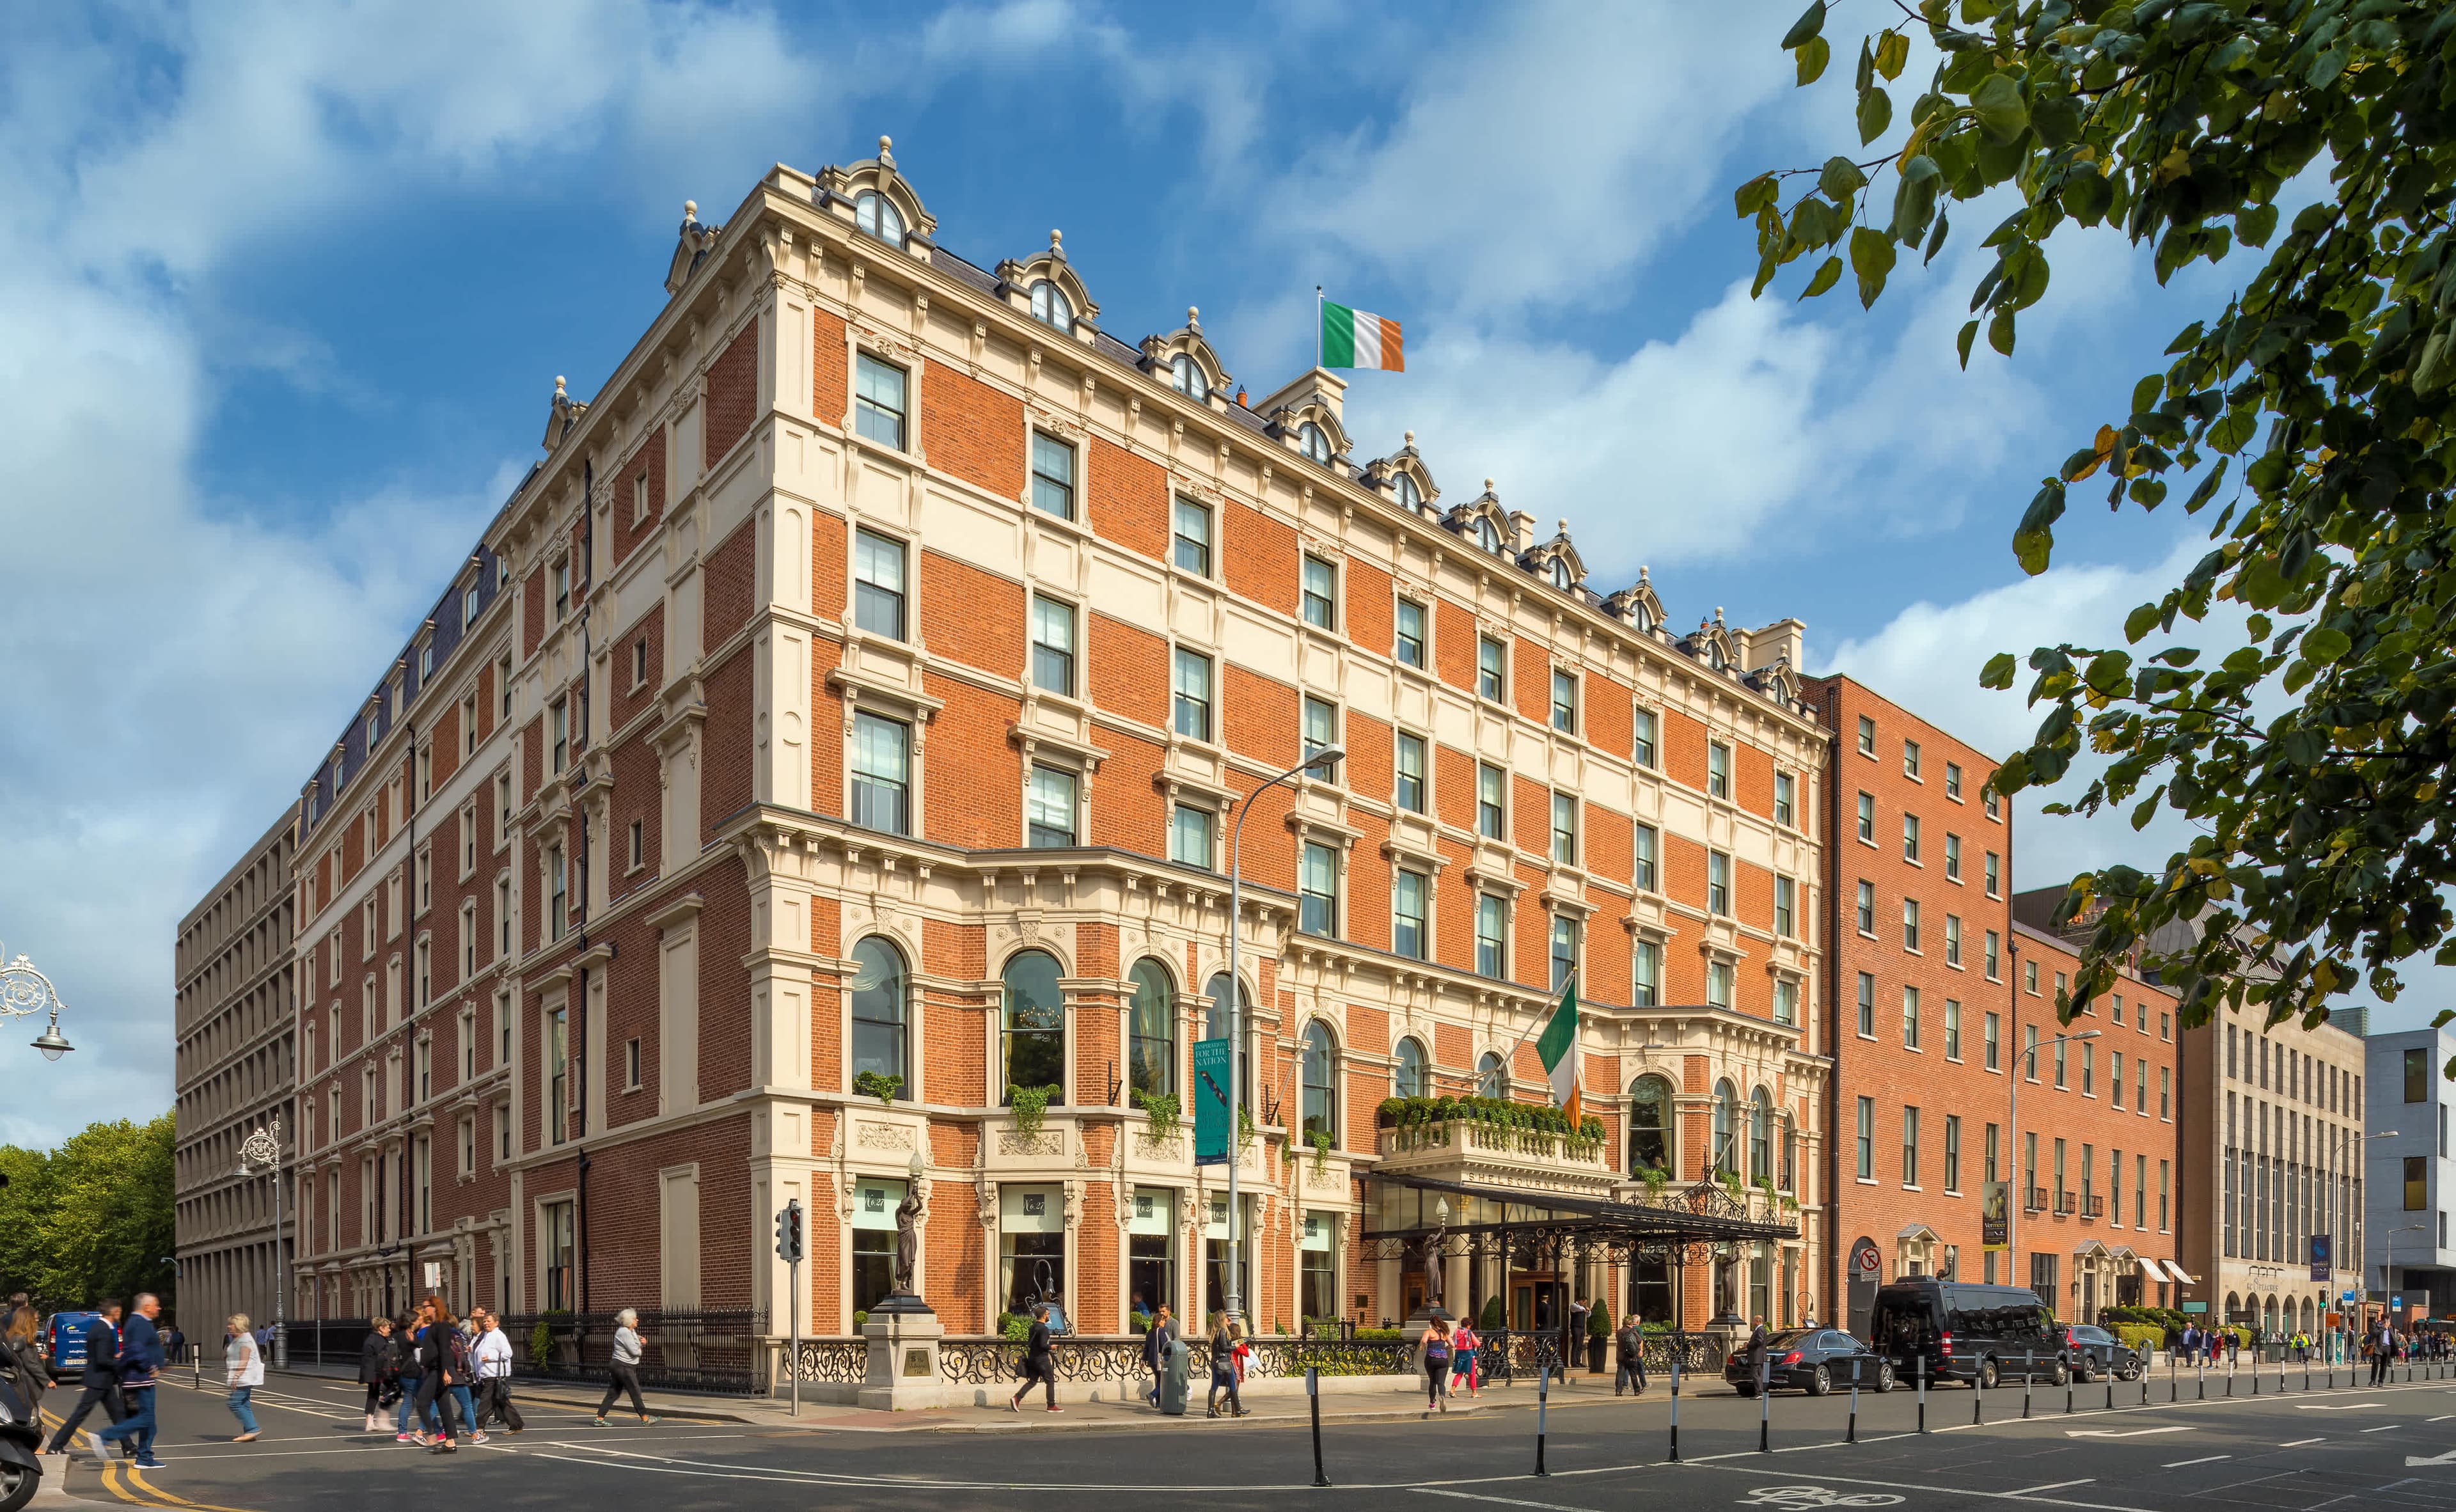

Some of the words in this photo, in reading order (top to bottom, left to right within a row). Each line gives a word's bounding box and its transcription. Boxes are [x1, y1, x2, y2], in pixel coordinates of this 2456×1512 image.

[1195, 1042, 1227, 1050] INSPIRATION
[1195, 1049, 1210, 1059] FOR
[1211, 1047, 1227, 1056] THE
[1195, 1055, 1227, 1067] NATION
[1468, 1172, 1559, 1190] SHELBOURNE
[1564, 1185, 1605, 1195] HOTEL
